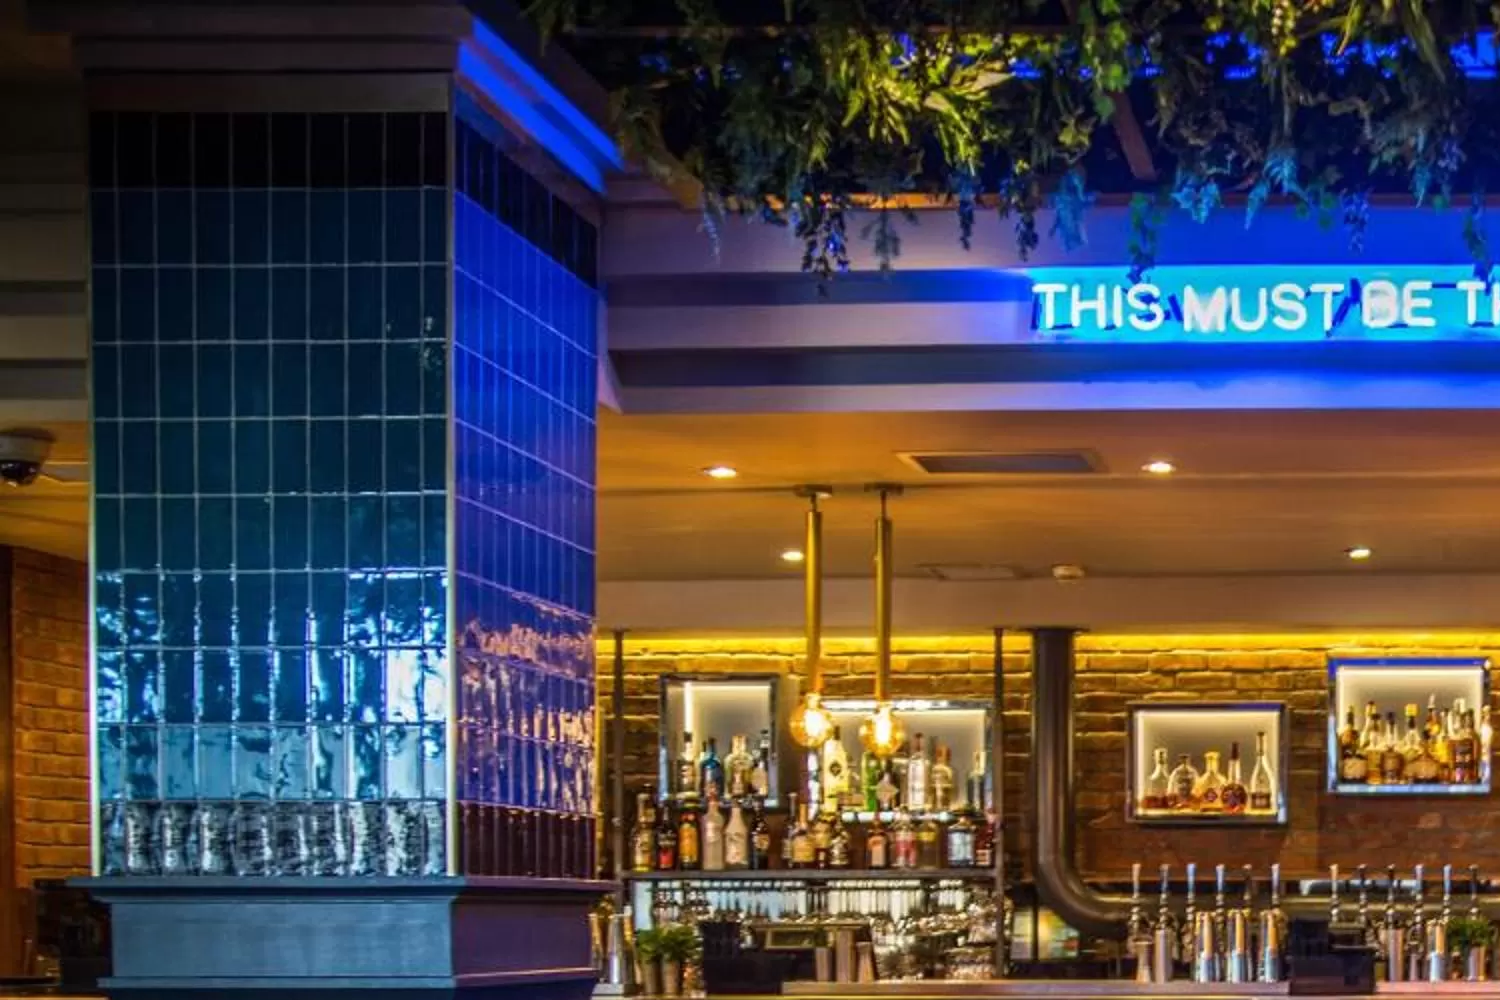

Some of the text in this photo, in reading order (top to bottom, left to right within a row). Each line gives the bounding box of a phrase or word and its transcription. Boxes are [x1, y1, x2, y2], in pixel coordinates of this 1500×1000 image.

[1031, 283, 1165, 331] THIS
[1183, 283, 1345, 332] MUST
[1361, 280, 1436, 328] BE
